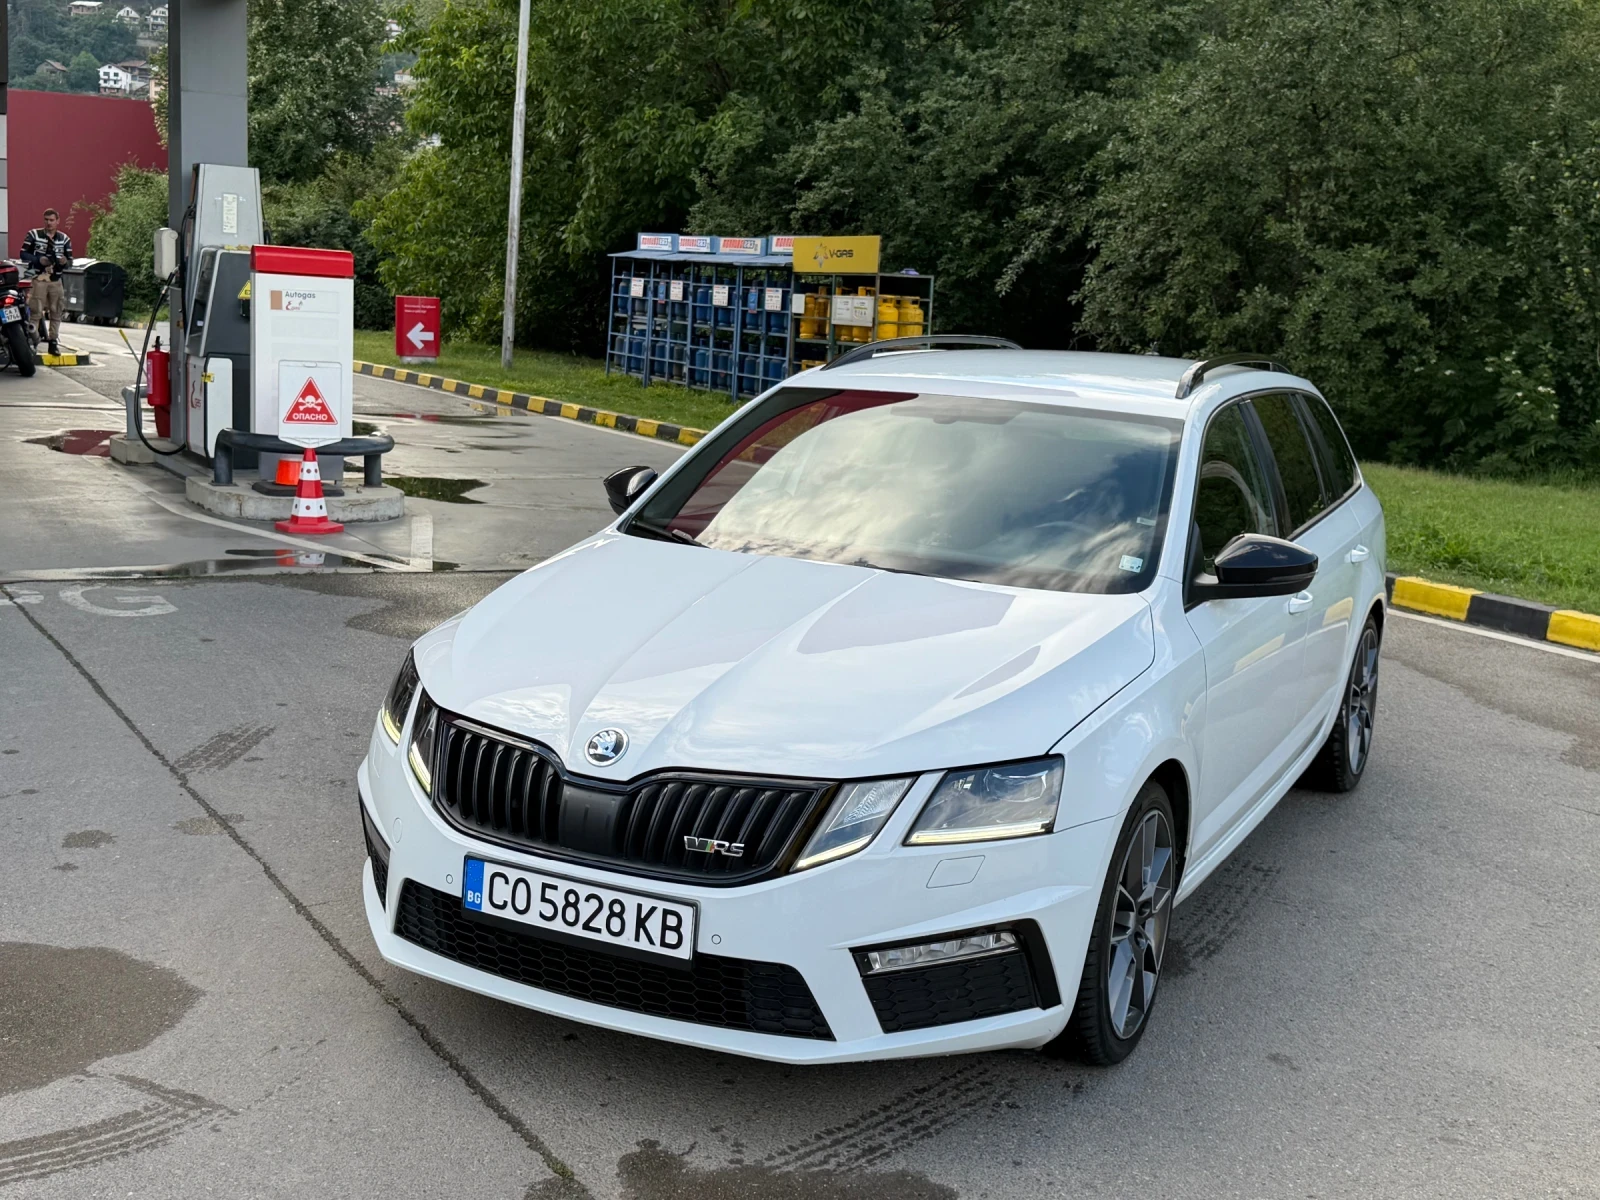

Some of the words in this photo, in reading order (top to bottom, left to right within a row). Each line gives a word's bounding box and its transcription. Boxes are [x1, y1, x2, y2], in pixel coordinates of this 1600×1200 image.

[829, 249, 854, 258] V-GAS
[285, 291, 316, 300] Autogas
[292, 412, 328, 421] ОПАСНО
[467, 890, 481, 904] BG
[488, 871, 531, 915] CO
[538, 881, 626, 938] 5828
[633, 903, 684, 950] KB
